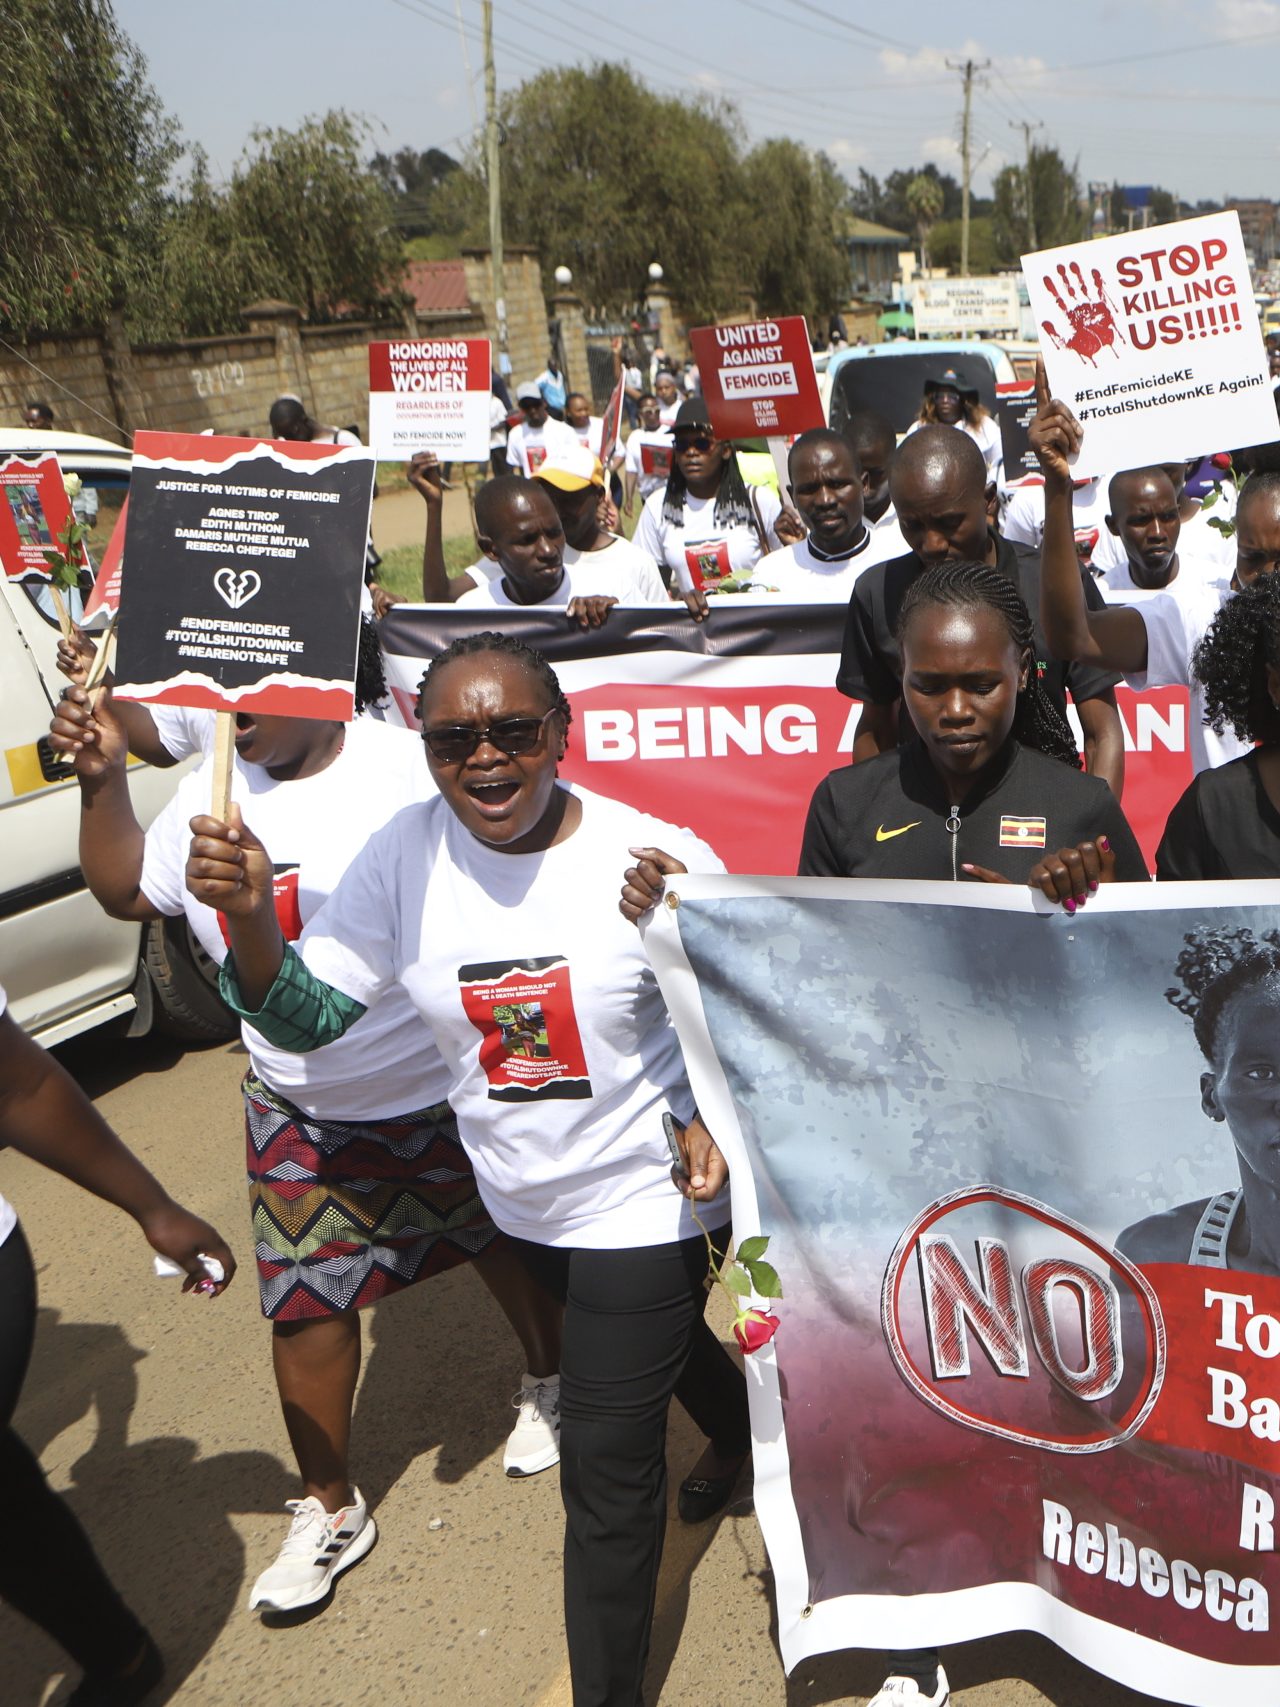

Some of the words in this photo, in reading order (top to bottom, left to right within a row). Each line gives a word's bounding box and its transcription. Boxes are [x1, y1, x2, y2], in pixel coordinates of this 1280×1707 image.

[1116, 238, 1228, 288] STOP
[1122, 275, 1237, 316] KILLING
[715, 322, 780, 347] UNITED
[1128, 302, 1242, 351] US!!!!!
[389, 342, 468, 360] HONORING
[723, 345, 783, 367] AGAINST
[390, 361, 408, 372] THE
[409, 361, 435, 372] LIVES
[436, 360, 449, 371] OF
[450, 360, 468, 371] ALL
[391, 372, 467, 392] WOMEN
[725, 371, 792, 390] FEMICIDE
[1074, 368, 1194, 403] #EndFemicideKE
[396, 401, 450, 409] REGARDLESS
[452, 401, 463, 409] OF
[752, 400, 774, 410] STOP
[1078, 383, 1215, 422] #TotalShutdownKE
[1218, 374, 1265, 394] Again!
[393, 432, 408, 440] END
[156, 480, 199, 493] JUSTICE
[201, 483, 222, 494] FOR
[225, 485, 268, 498] VICTIMS
[270, 488, 284, 498] OF
[286, 490, 340, 503] FEMICIDE!
[209, 507, 245, 519] AGNES
[247, 510, 279, 521] TIROP
[201, 519, 233, 530] EDITH
[235, 521, 285, 533] MUTHONI
[175, 528, 222, 541] DAMARIS
[224, 532, 268, 544] MUTHEE
[270, 536, 310, 548] MUTUA
[186, 540, 234, 553] REBECCA
[236, 545, 296, 558] CHEPTEGEI
[180, 617, 290, 637] #ENDFEMICIDEKE
[165, 630, 304, 652] #TOTALSHUTDOWNKE
[178, 645, 288, 665] #WEARENOTSAFE
[583, 703, 818, 762] BEING
[916, 1234, 1124, 1401] NO
[1042, 1498, 1270, 1632] Rebecca
